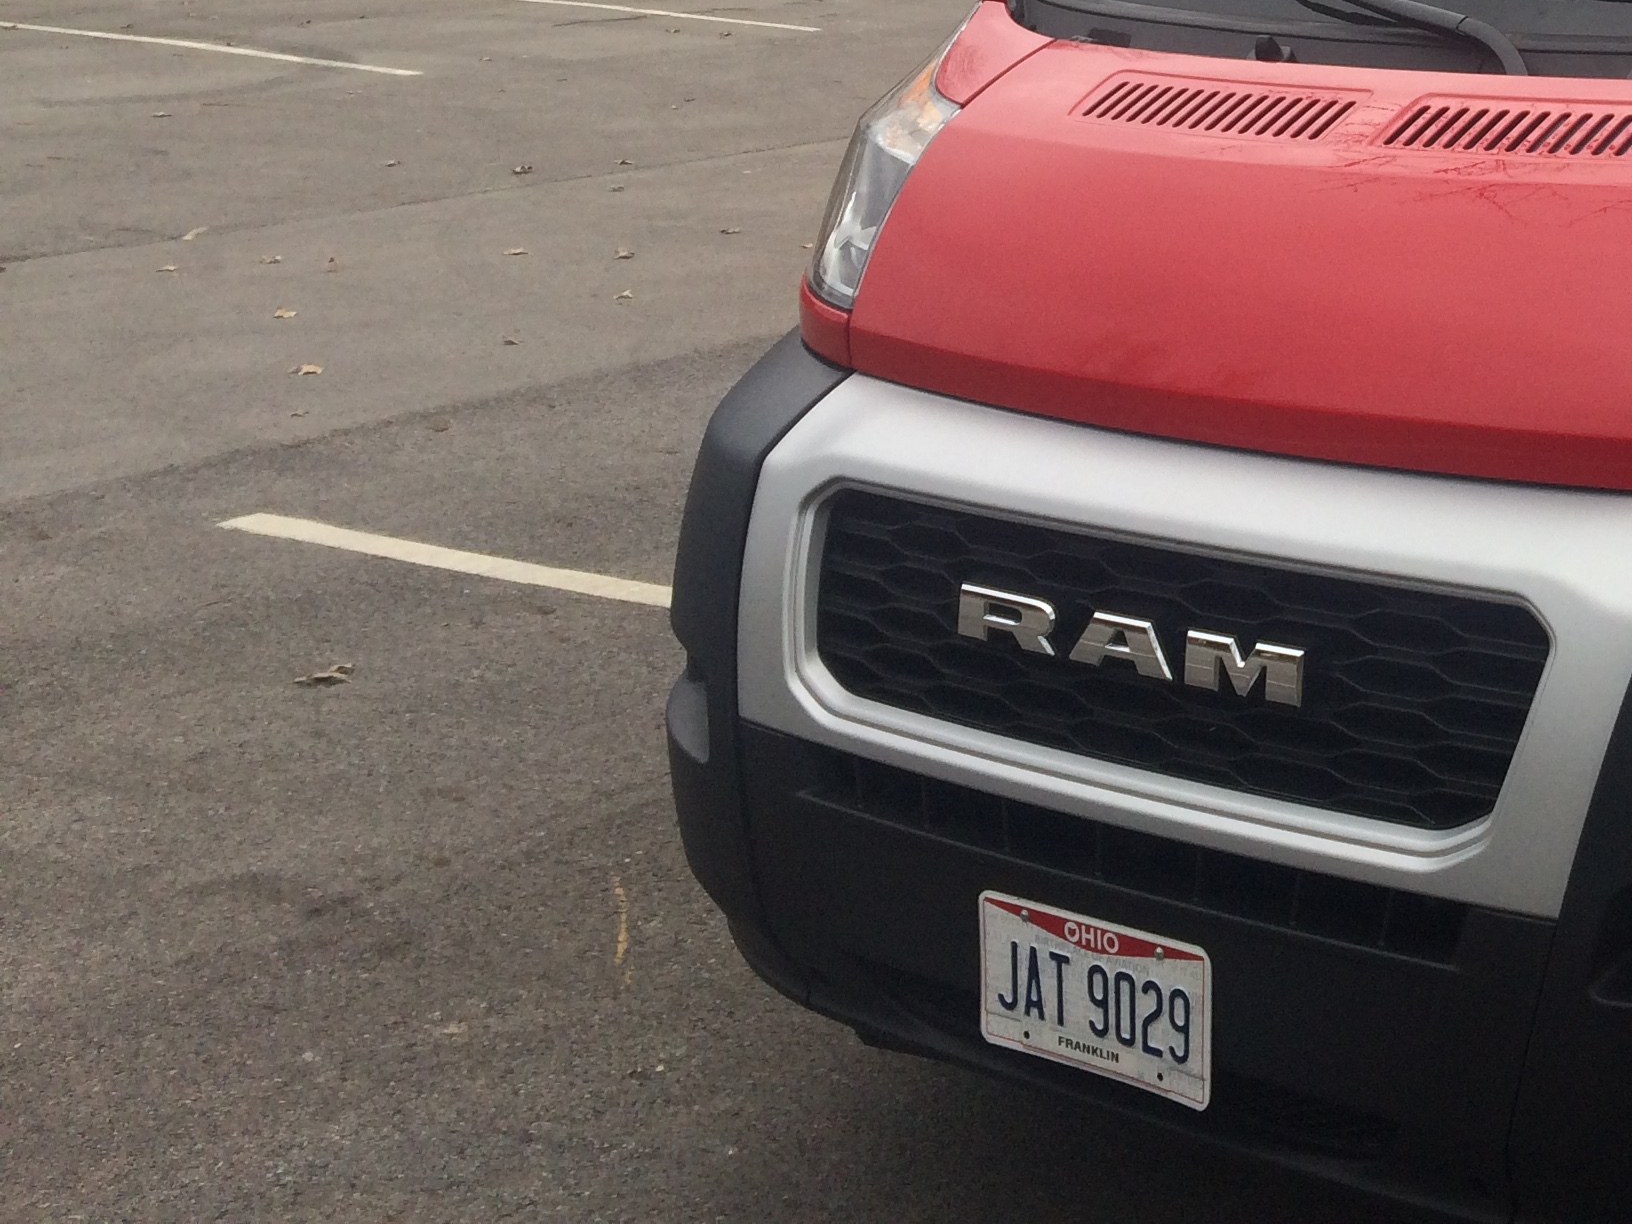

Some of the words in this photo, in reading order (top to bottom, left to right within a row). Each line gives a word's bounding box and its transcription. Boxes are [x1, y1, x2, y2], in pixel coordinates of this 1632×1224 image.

[956, 580, 1305, 707] RAM
[1063, 921, 1119, 954] OHIO
[997, 940, 1070, 1027] JAT
[1087, 963, 1191, 1065] 9029
[1057, 1035, 1120, 1064] FRANKLIN
